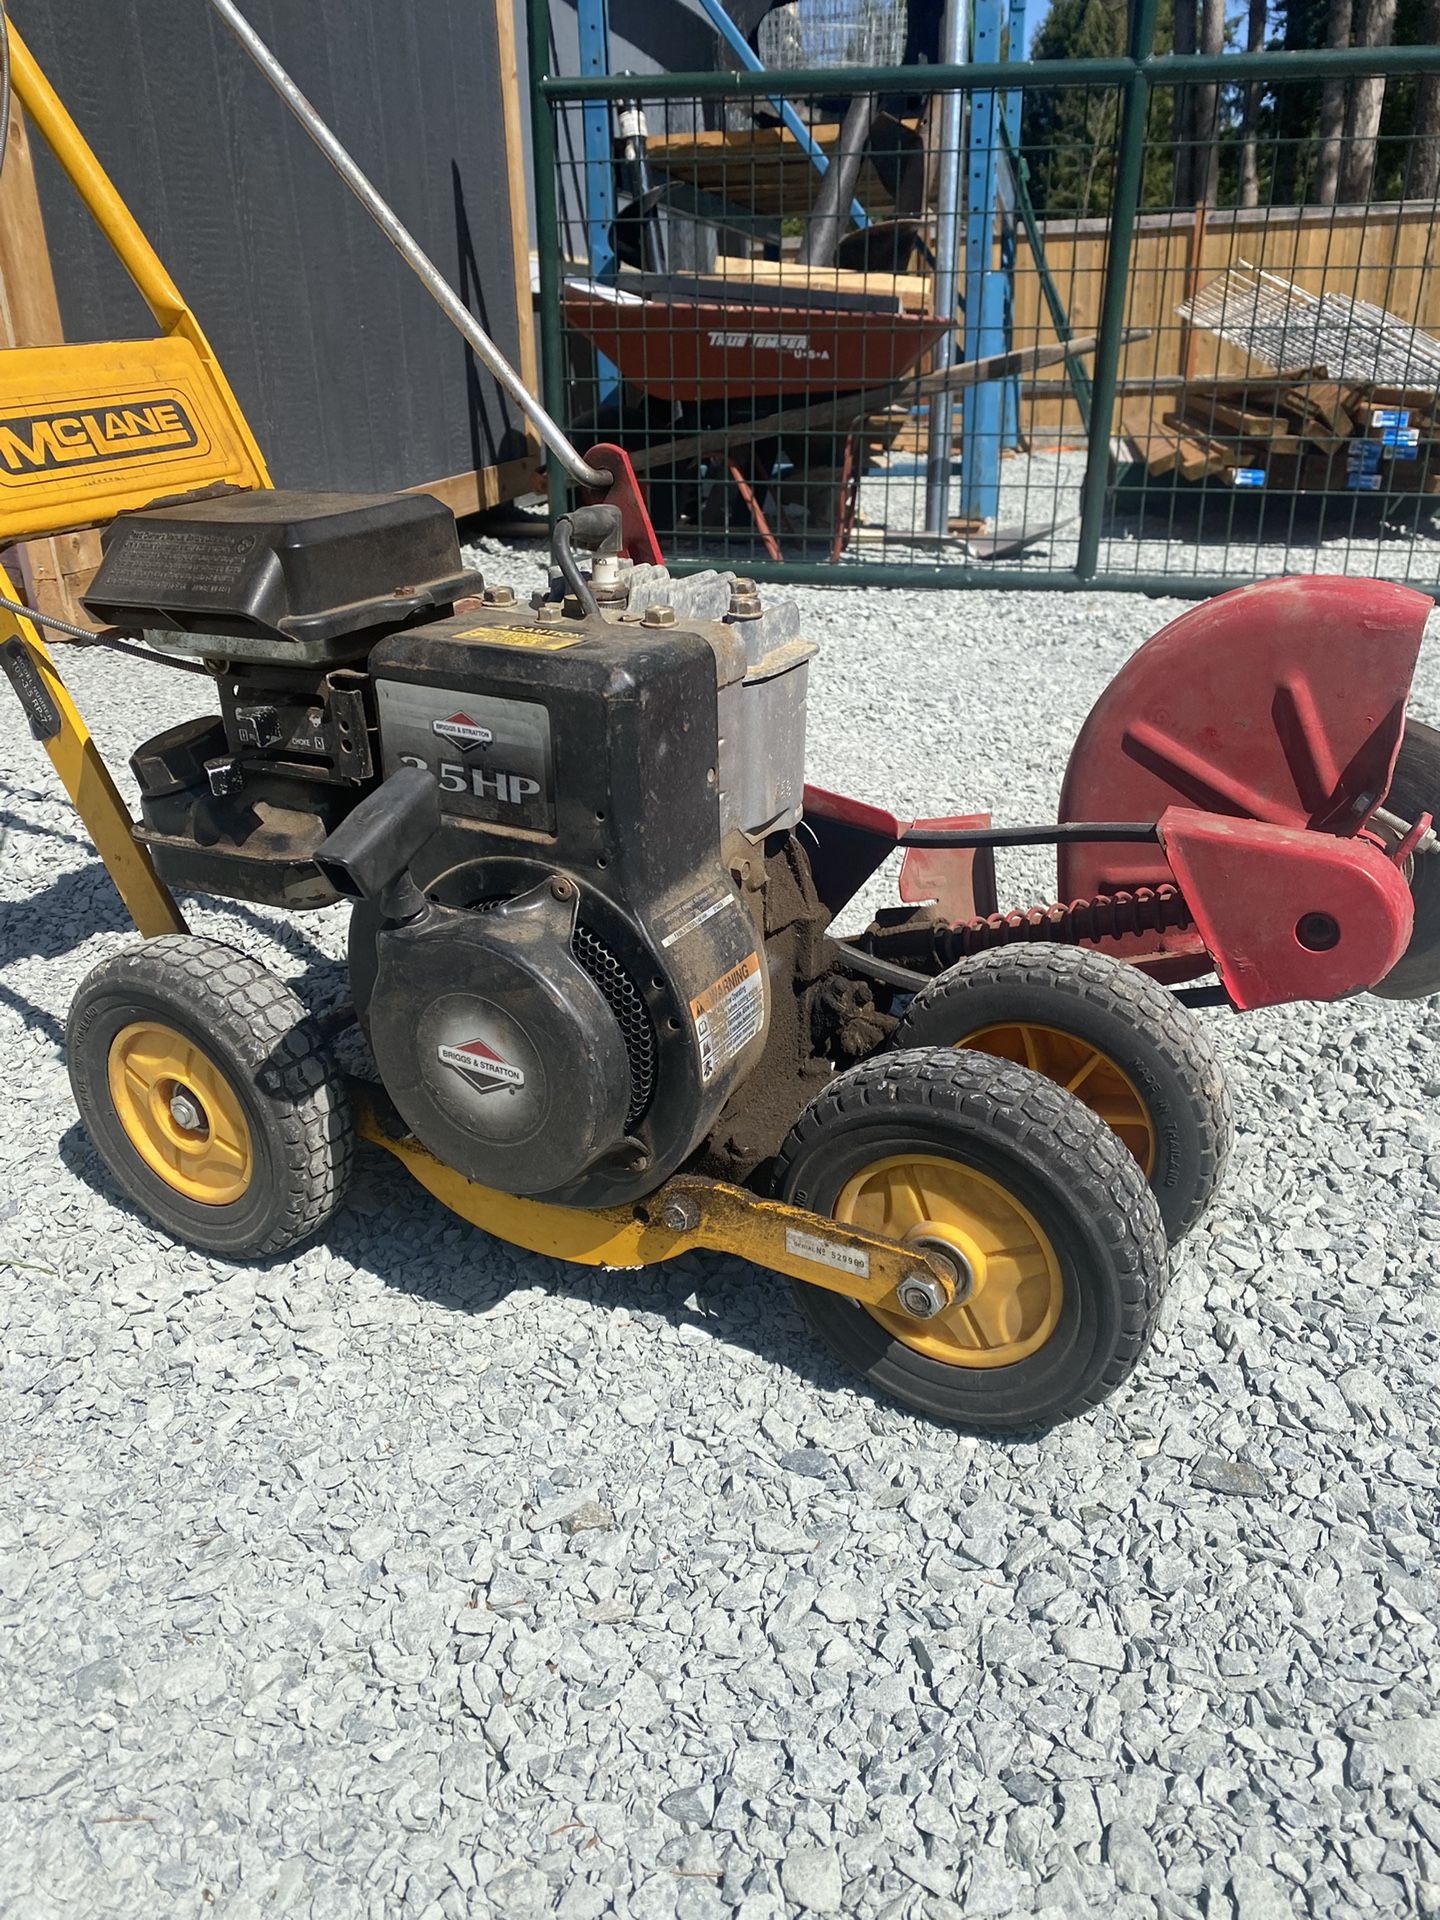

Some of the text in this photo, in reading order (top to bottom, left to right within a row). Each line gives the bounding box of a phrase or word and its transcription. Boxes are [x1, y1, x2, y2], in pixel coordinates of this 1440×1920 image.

[708, 332, 808, 349] TRUE TEMPER
[512, 626, 585, 638] CAUTION
[16, 655, 53, 720] MODEL NUMBER
[32, 699, 48, 722] RP-7
[435, 723, 457, 732] BRIGGS
[462, 728, 490, 738] STRATTON
[292, 738, 311, 747] CHOKE
[709, 964, 750, 1001] WARNING
[442, 1049, 520, 1080] BRIGGS & STRATTON
[1164, 1120, 1180, 1187] THAILAND
